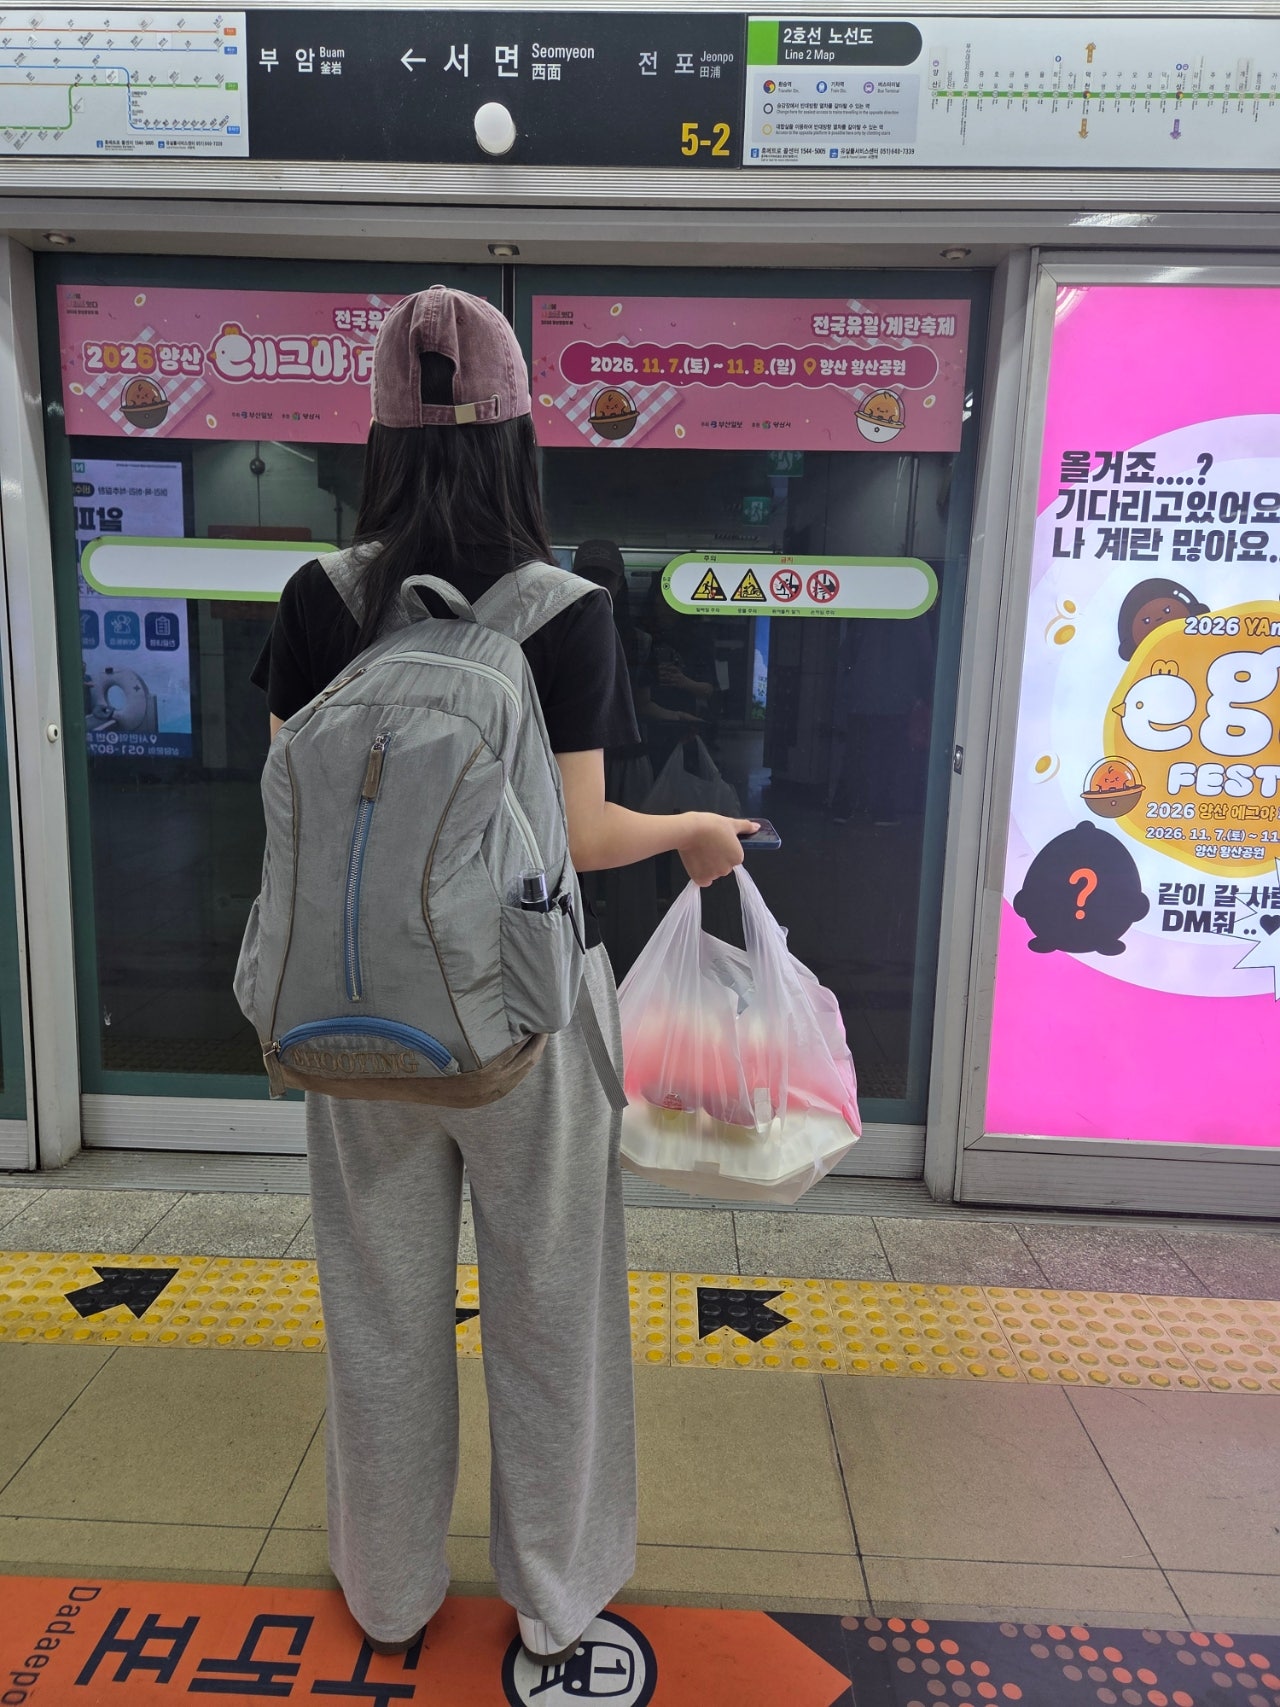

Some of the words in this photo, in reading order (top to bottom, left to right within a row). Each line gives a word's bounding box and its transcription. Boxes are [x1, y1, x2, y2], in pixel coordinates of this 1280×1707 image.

[783, 27, 822, 46] 2호선
[828, 27, 874, 45] 노선도
[319, 46, 345, 59] Buam
[531, 41, 596, 62] Seomyeon
[699, 50, 734, 65] Jeonpo
[785, 49, 804, 60] Line
[806, 49, 812, 60] 2
[814, 49, 835, 62] Map
[319, 60, 342, 76] 釜岩
[531, 63, 562, 81] 西面
[699, 65, 721, 79] 田浦
[681, 121, 731, 157] 5-2
[335, 309, 390, 330] 전국유
[812, 315, 880, 336] 전국유일
[885, 315, 956, 337] 계란축제
[87, 346, 155, 370] 2026
[160, 346, 202, 371] 양산
[591, 356, 639, 374] 2026.
[642, 357, 664, 375] 11.
[727, 358, 750, 376] 11.
[819, 358, 849, 377] 양산
[851, 358, 907, 377] 황산공원
[1052, 526, 1086, 560] 나
[1094, 527, 1165, 561] 계란
[1171, 528, 1280, 563] 많아요.
[703, 555, 718, 563] 주의
[1184, 616, 1241, 637] 2026
[1113, 646, 1280, 758] eg
[1145, 802, 1196, 820] 2026
[1198, 802, 1230, 821] 양산
[1230, 804, 1277, 822] 에그야
[1145, 826, 1187, 841] 2026.
[1188, 829, 1212, 842] 11.
[1213, 829, 1247, 842] 7.(토)
[1194, 844, 1219, 859] 양산
[1219, 845, 1266, 860] 황산공원
[1157, 882, 1206, 908] 같이
[1214, 884, 1240, 908] 갈
[1, 1585, 102, 1706] Dadaepo
[594, 1658, 627, 1676] 1
